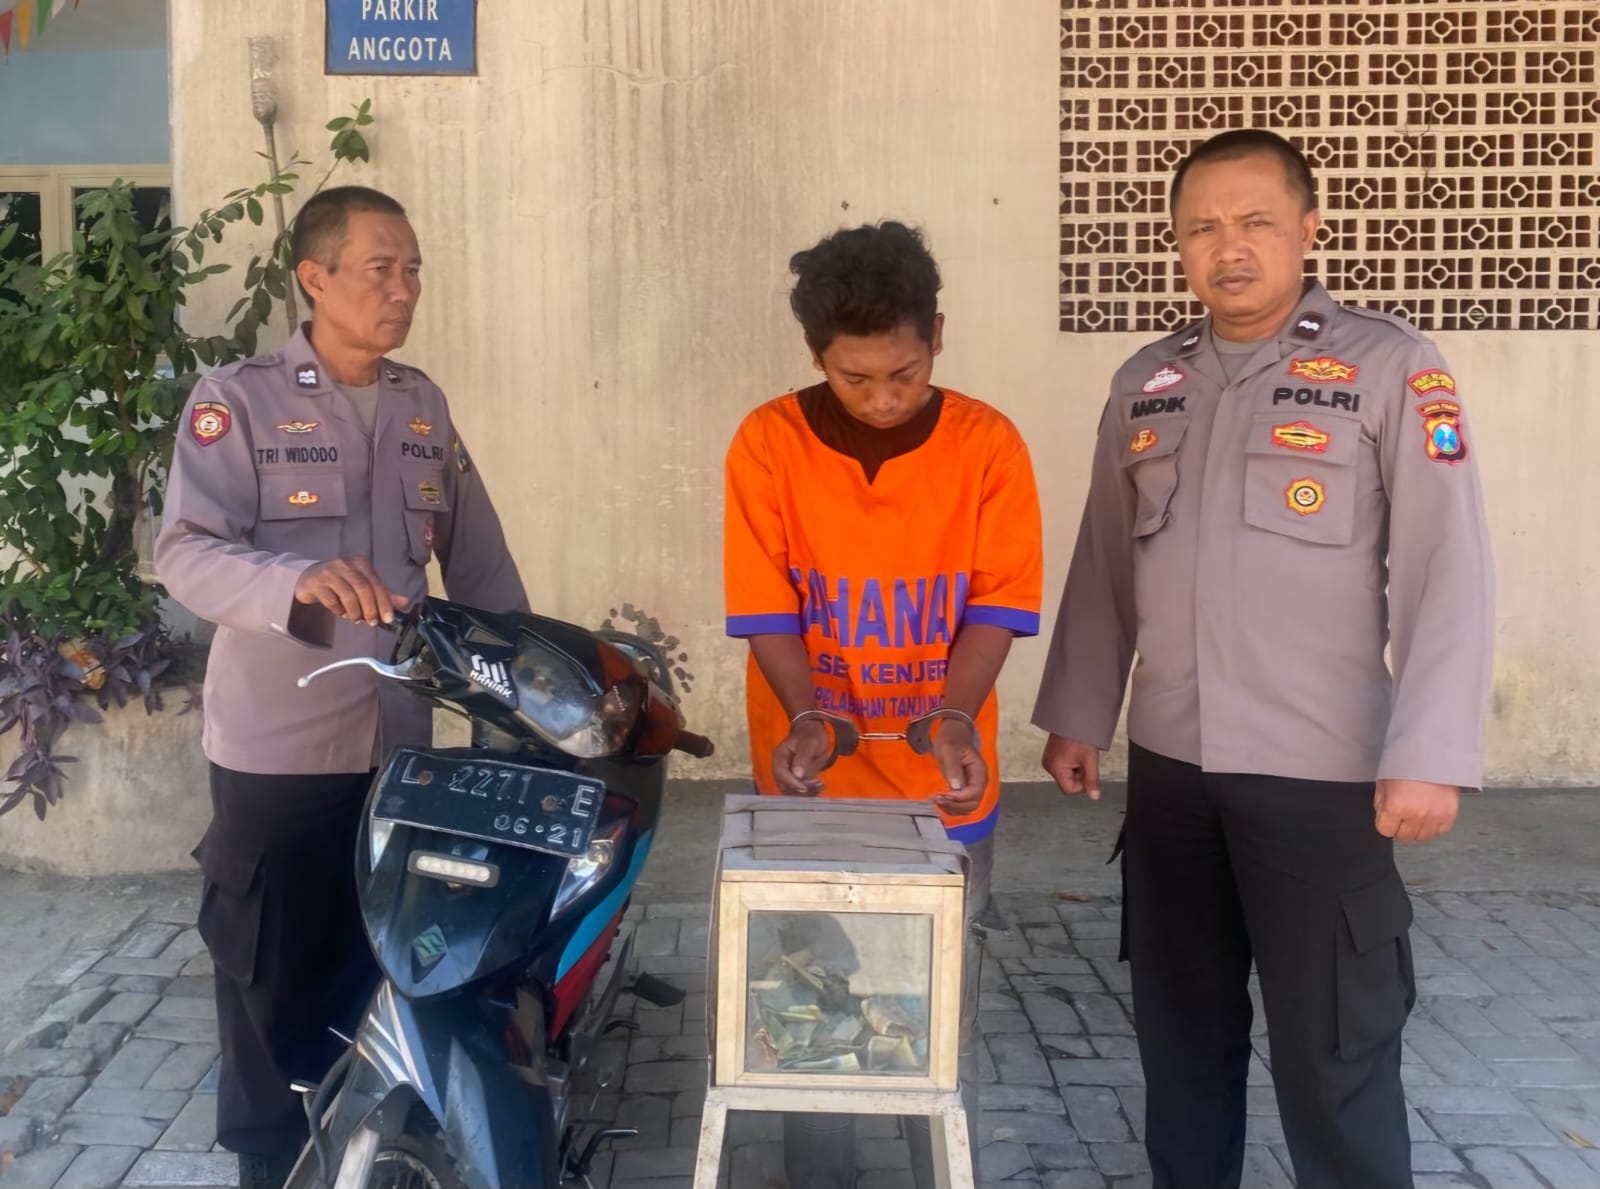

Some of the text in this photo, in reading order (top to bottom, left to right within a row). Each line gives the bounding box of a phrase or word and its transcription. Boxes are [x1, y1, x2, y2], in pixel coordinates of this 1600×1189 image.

[361, 0, 439, 21] PARKIR
[347, 36, 452, 61] ANGGOTA
[1130, 396, 1187, 420] ANDIK
[1272, 387, 1360, 413] POLRI
[257, 446, 338, 465] TRI WIDODO
[401, 442, 444, 462] POLRI
[789, 567, 969, 648] AHANA
[861, 659, 948, 685] KENJER
[401, 756, 422, 785] L
[571, 784, 596, 817] E
